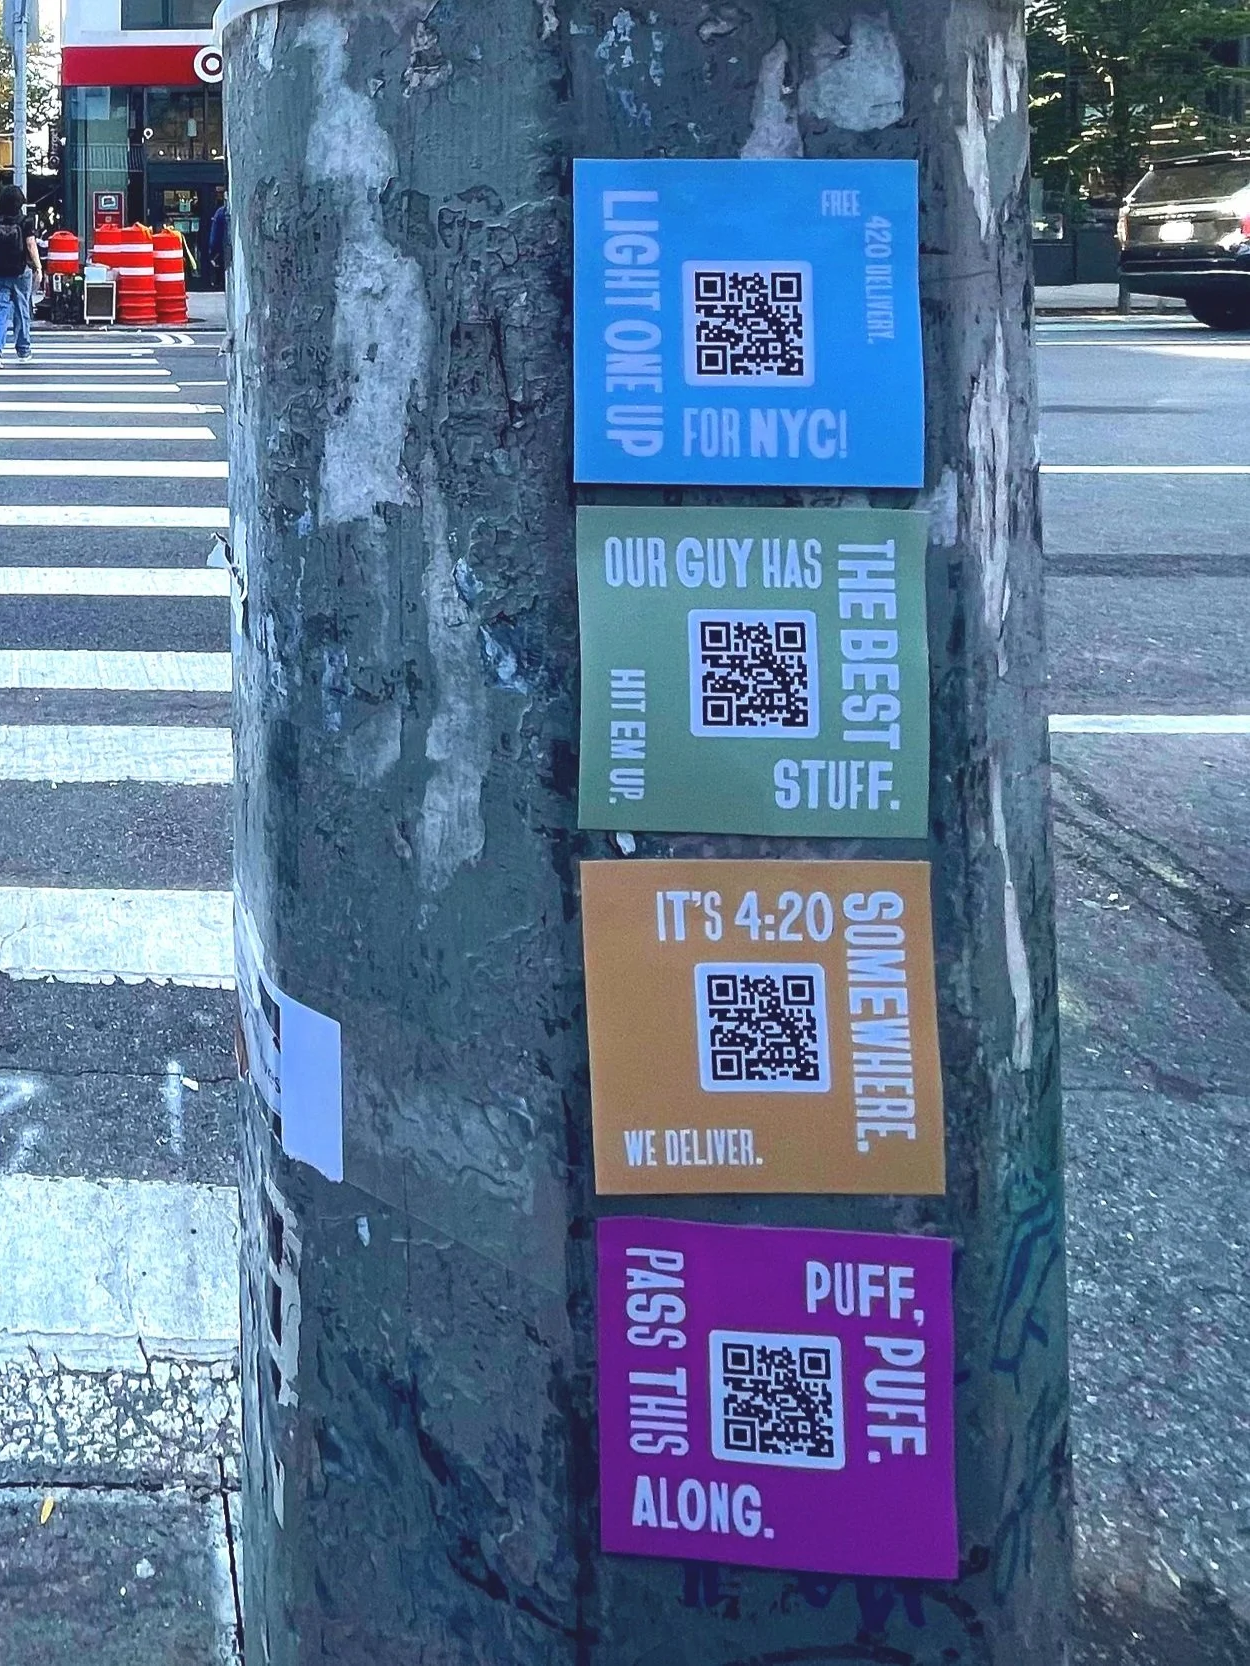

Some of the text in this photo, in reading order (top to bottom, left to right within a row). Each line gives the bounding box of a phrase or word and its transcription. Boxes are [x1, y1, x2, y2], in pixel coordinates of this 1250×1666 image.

[821, 190, 860, 216] FREE
[864, 215, 894, 344] 420 DELIVERY.
[603, 190, 664, 457] LIGHT ONE UP
[682, 407, 847, 459] FOR NYC!
[604, 536, 822, 589] OUR GUY HAS
[837, 539, 901, 750] THE BEST
[608, 668, 646, 804] HIT EM UP.
[773, 759, 900, 811] STUFF.
[655, 890, 834, 942] IT'S 4:20
[842, 891, 917, 1153] SOMEWHERE.
[623, 1128, 764, 1166] WE DELIVER.
[805, 1260, 924, 1327] PUFF,
[625, 1247, 690, 1456] PASS THIS
[864, 1335, 928, 1464] PUFF.
[632, 1475, 775, 1539] ALONG.
